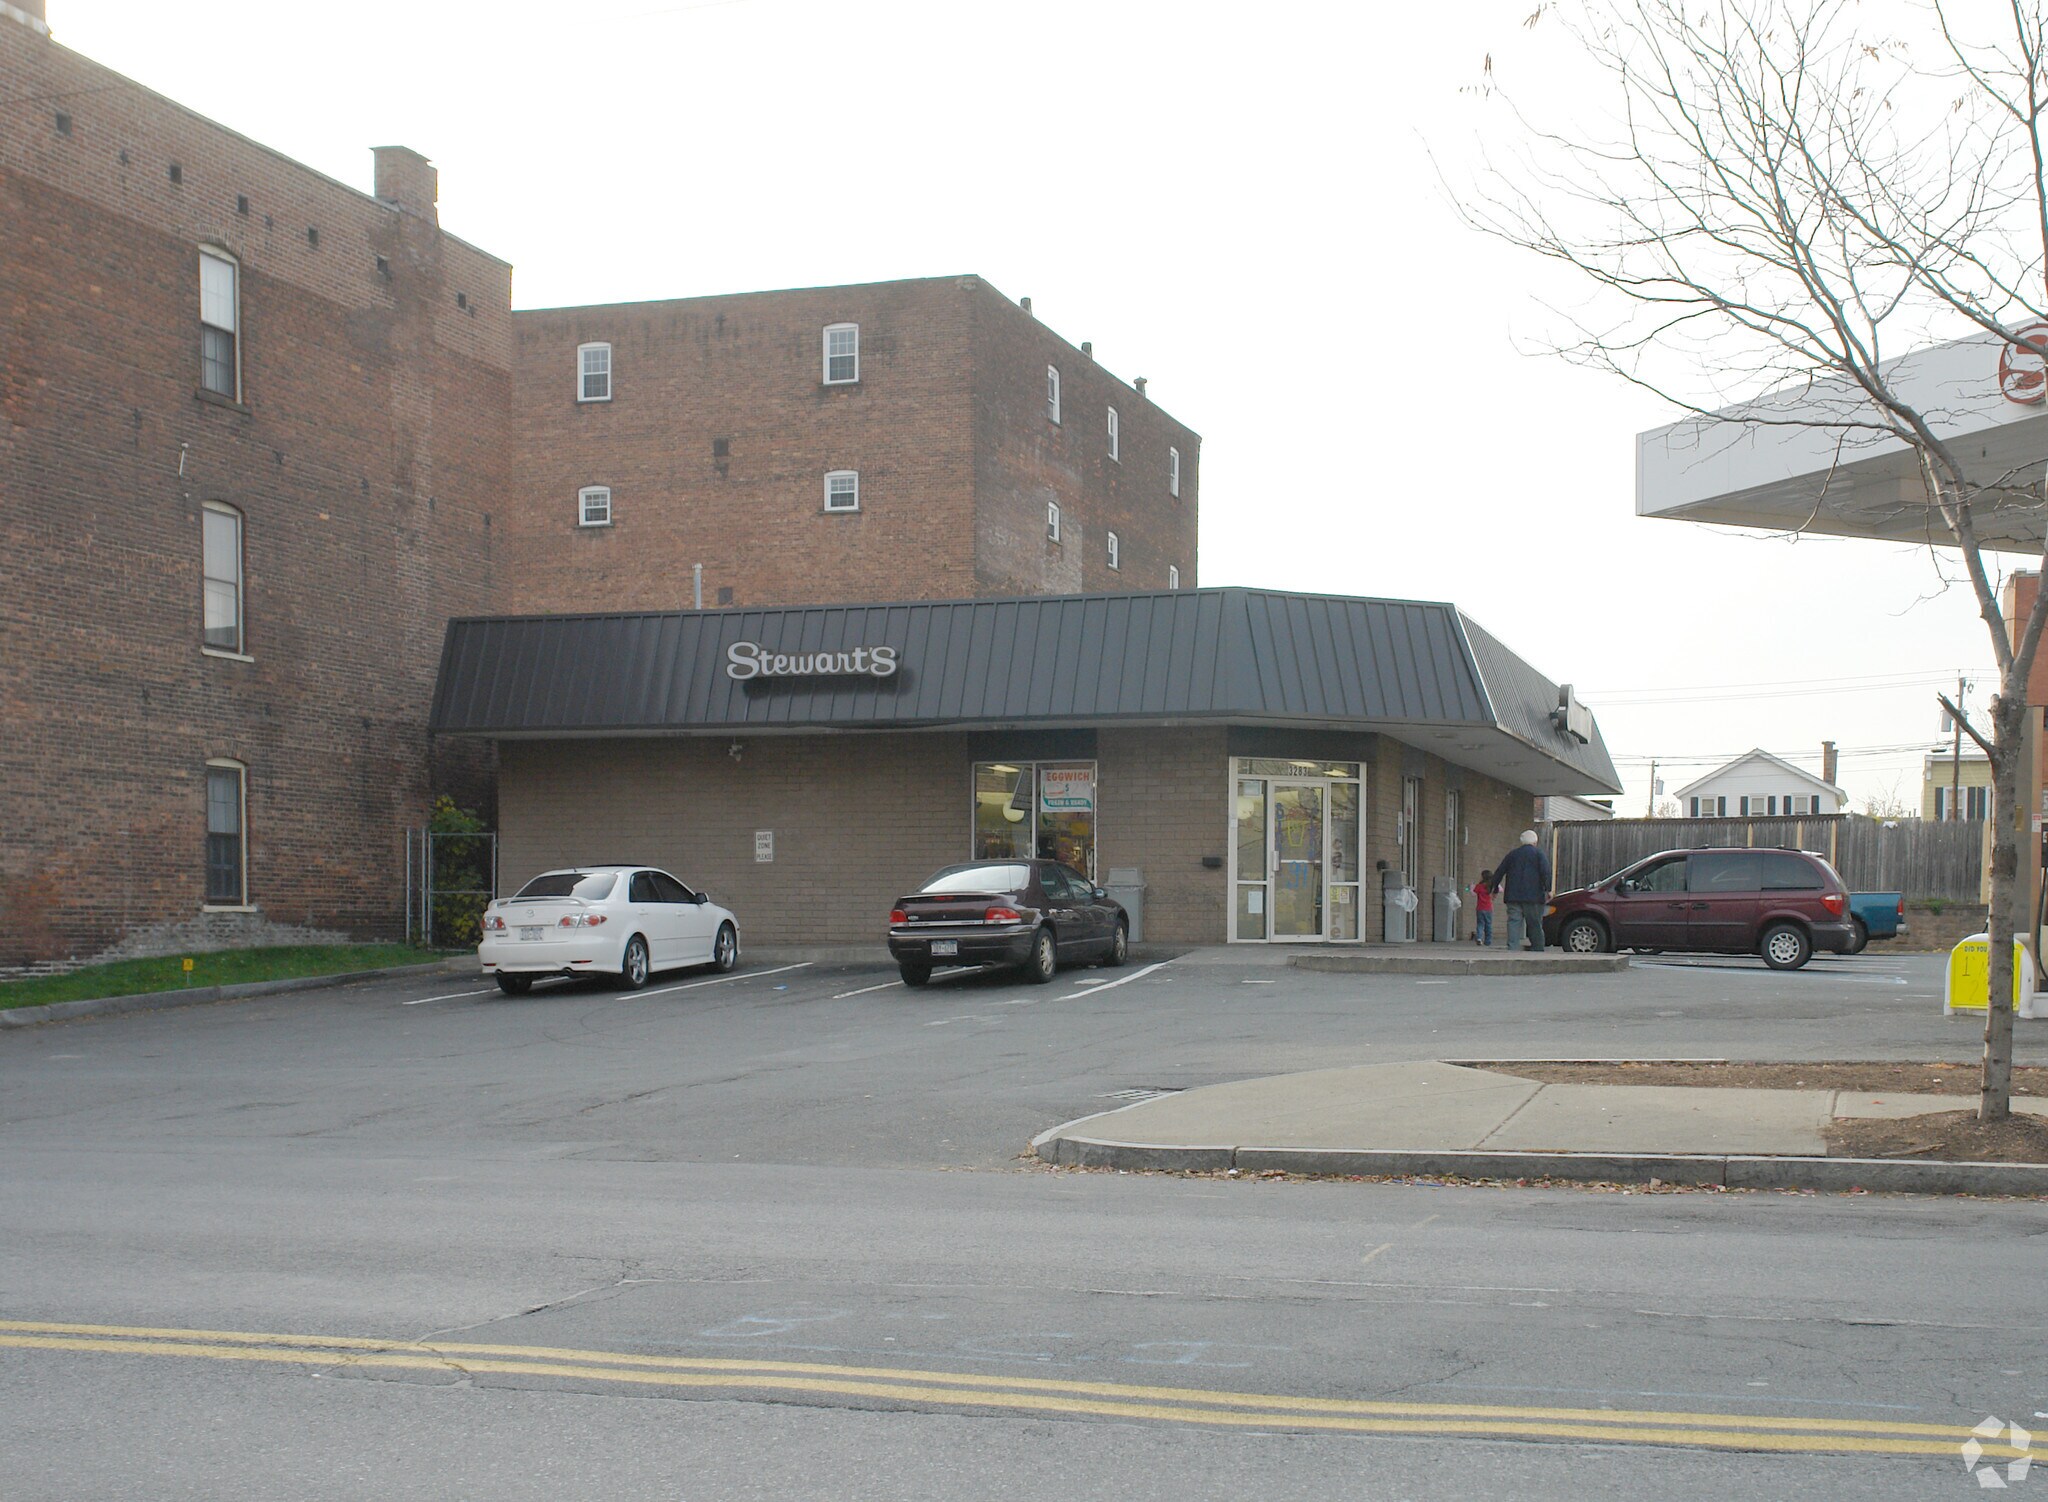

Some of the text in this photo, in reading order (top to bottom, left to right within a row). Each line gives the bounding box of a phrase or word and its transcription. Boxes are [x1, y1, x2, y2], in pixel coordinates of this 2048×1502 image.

[1288, 766, 1309, 777] 3283
[1046, 771, 1090, 782] EGGWICH
[757, 833, 771, 841] QUIET
[757, 842, 771, 850] ZONE
[1964, 945, 1975, 953] DID
